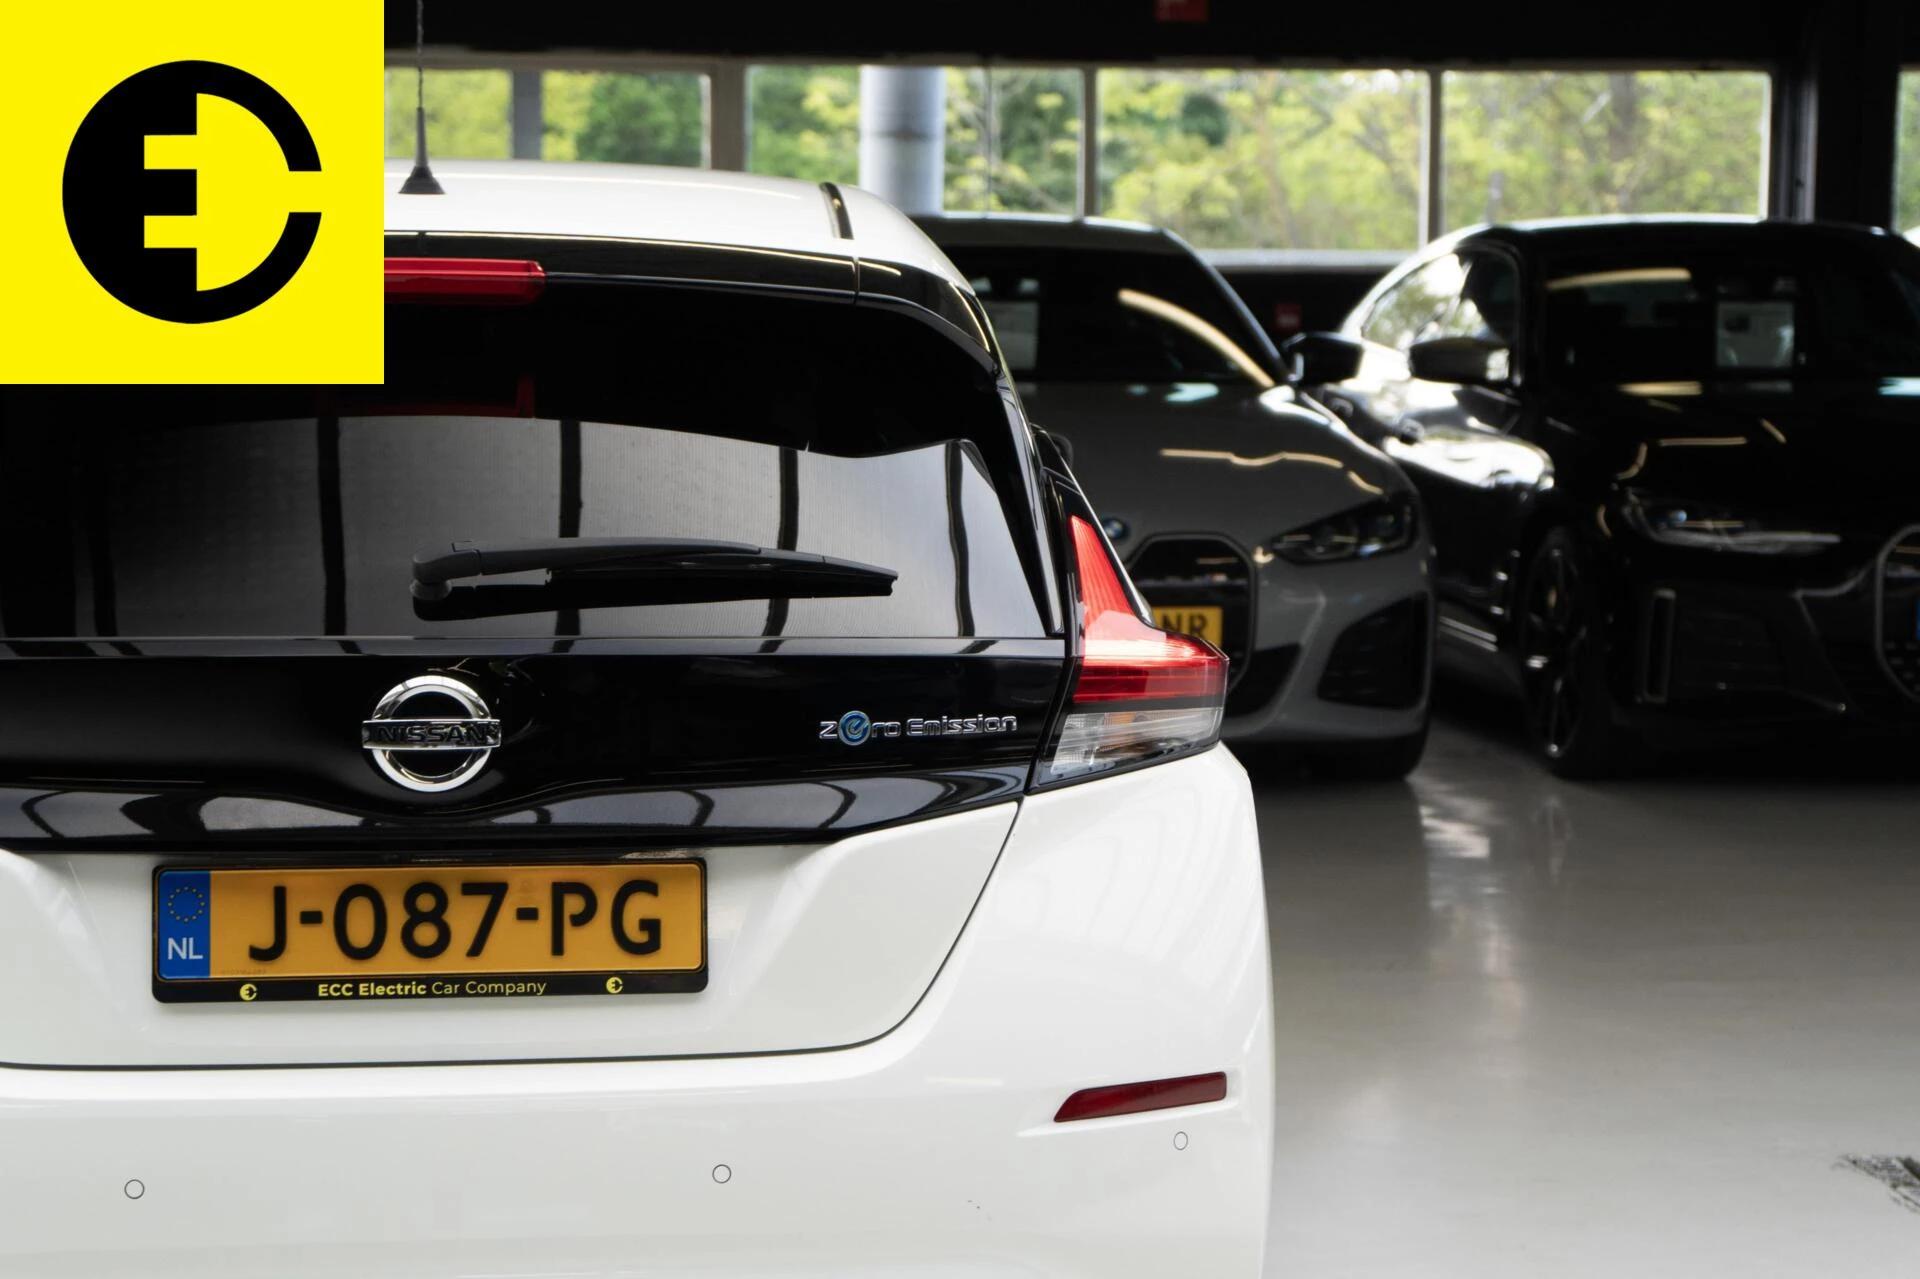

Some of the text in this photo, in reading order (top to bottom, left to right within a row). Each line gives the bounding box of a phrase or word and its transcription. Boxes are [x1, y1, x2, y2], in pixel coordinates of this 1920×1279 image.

[376, 725, 488, 742] NISSAN
[906, 714, 1017, 736] Emission
[247, 879, 663, 963] J-087-PG
[167, 936, 203, 961] NL
[317, 980, 547, 997] ECC Electric Car Company
